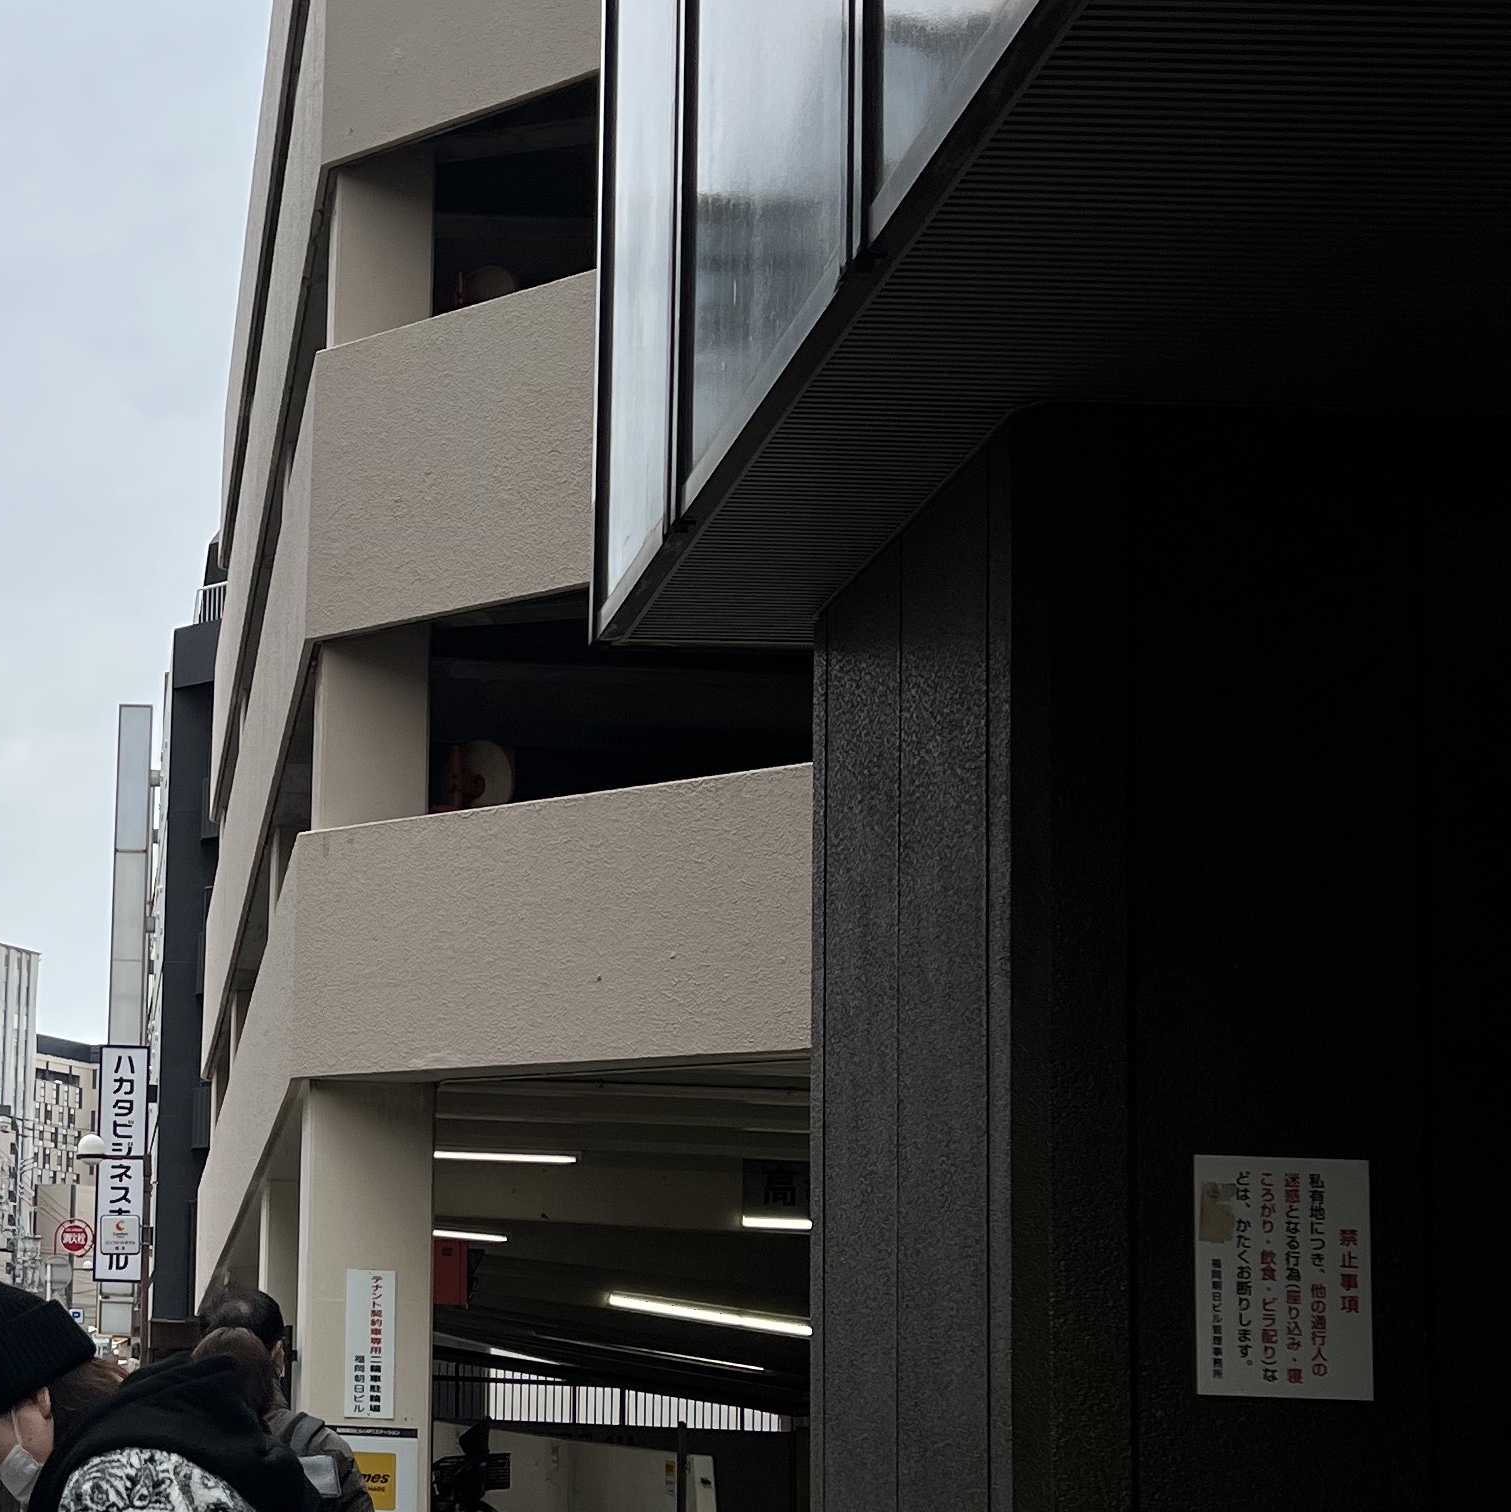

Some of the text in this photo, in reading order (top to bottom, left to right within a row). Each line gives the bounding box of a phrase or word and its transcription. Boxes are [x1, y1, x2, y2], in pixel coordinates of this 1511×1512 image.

[107, 1055, 136, 1271] ハカタビジネスル
[1339, 1228, 1360, 1314] 禁止事項
[361, 1473, 390, 1483] mes
